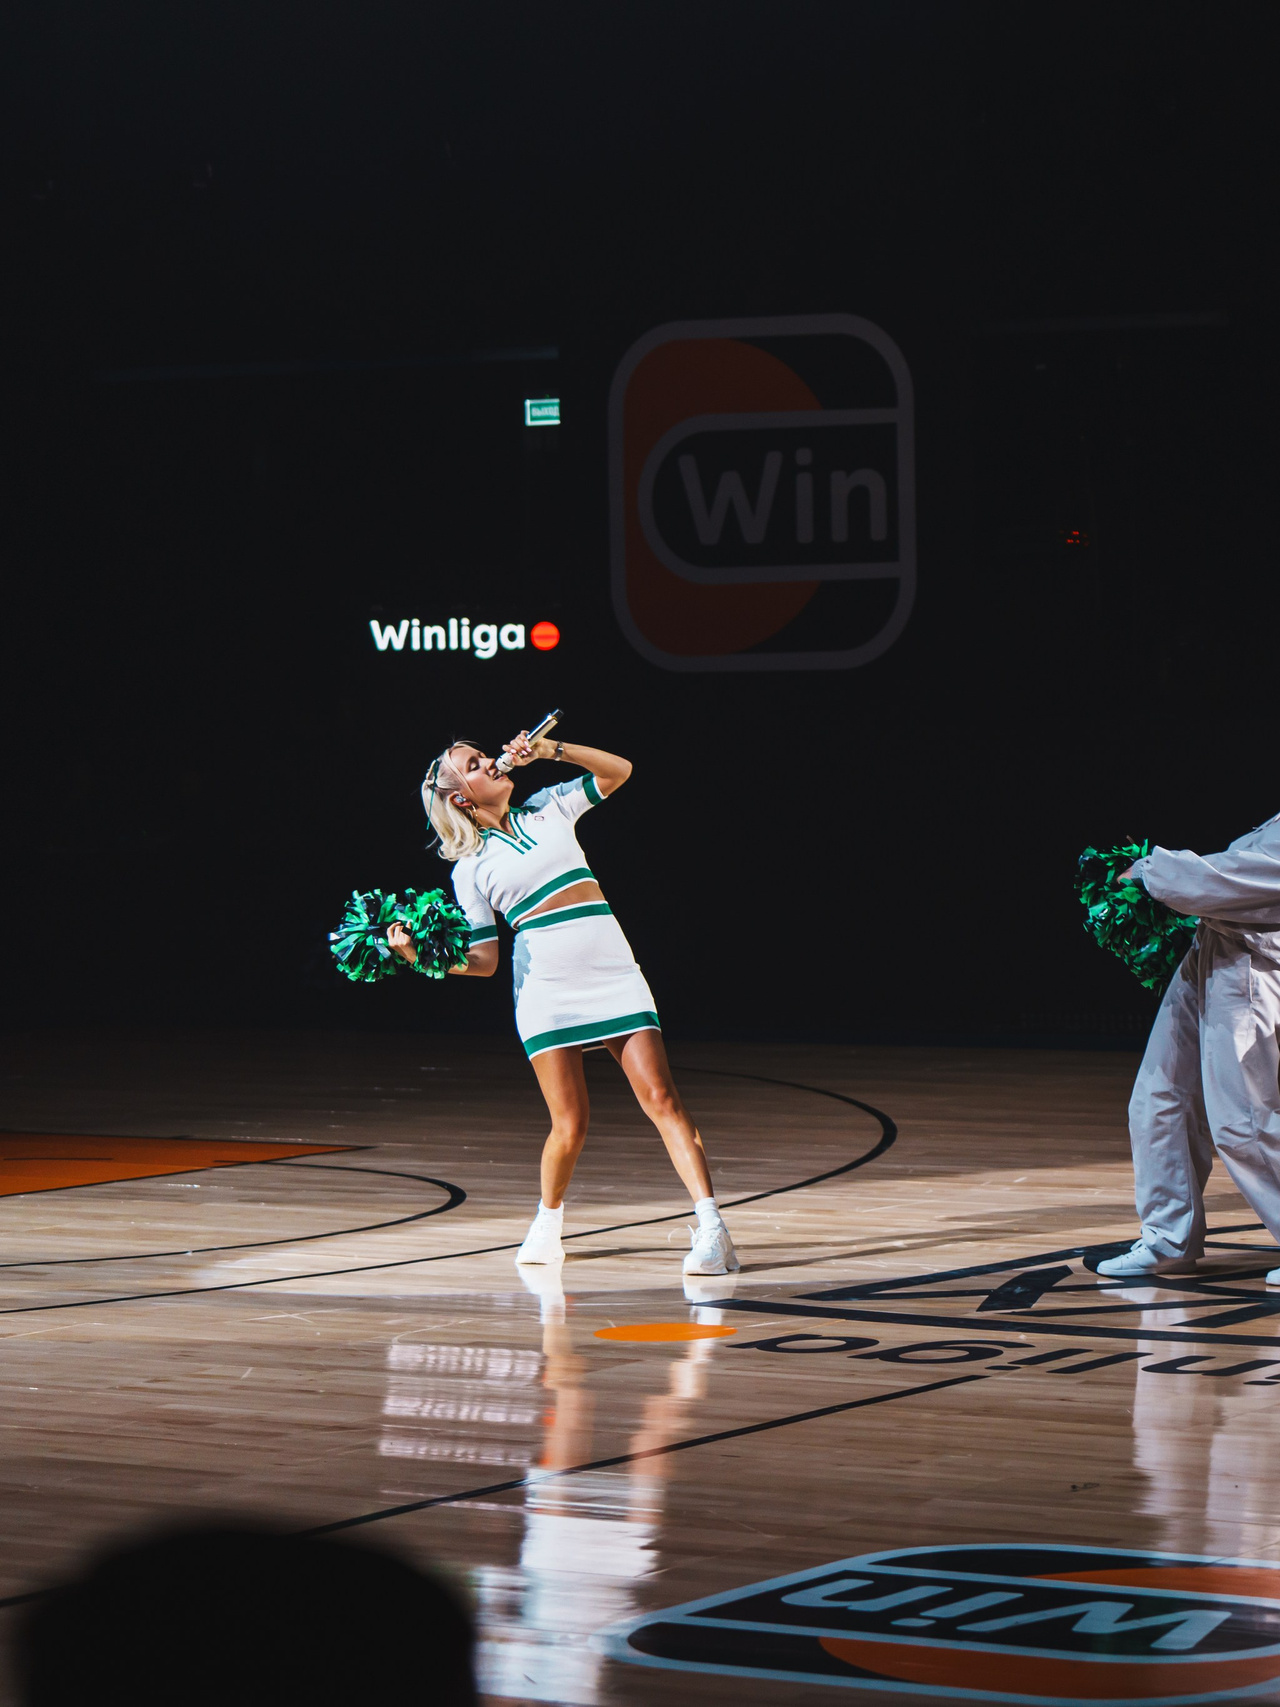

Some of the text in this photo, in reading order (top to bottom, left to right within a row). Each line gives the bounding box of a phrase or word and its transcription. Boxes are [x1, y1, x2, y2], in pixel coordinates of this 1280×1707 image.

[678, 448, 887, 546] Win
[369, 617, 525, 659] Winliga
[781, 1579, 1232, 1650] Win
